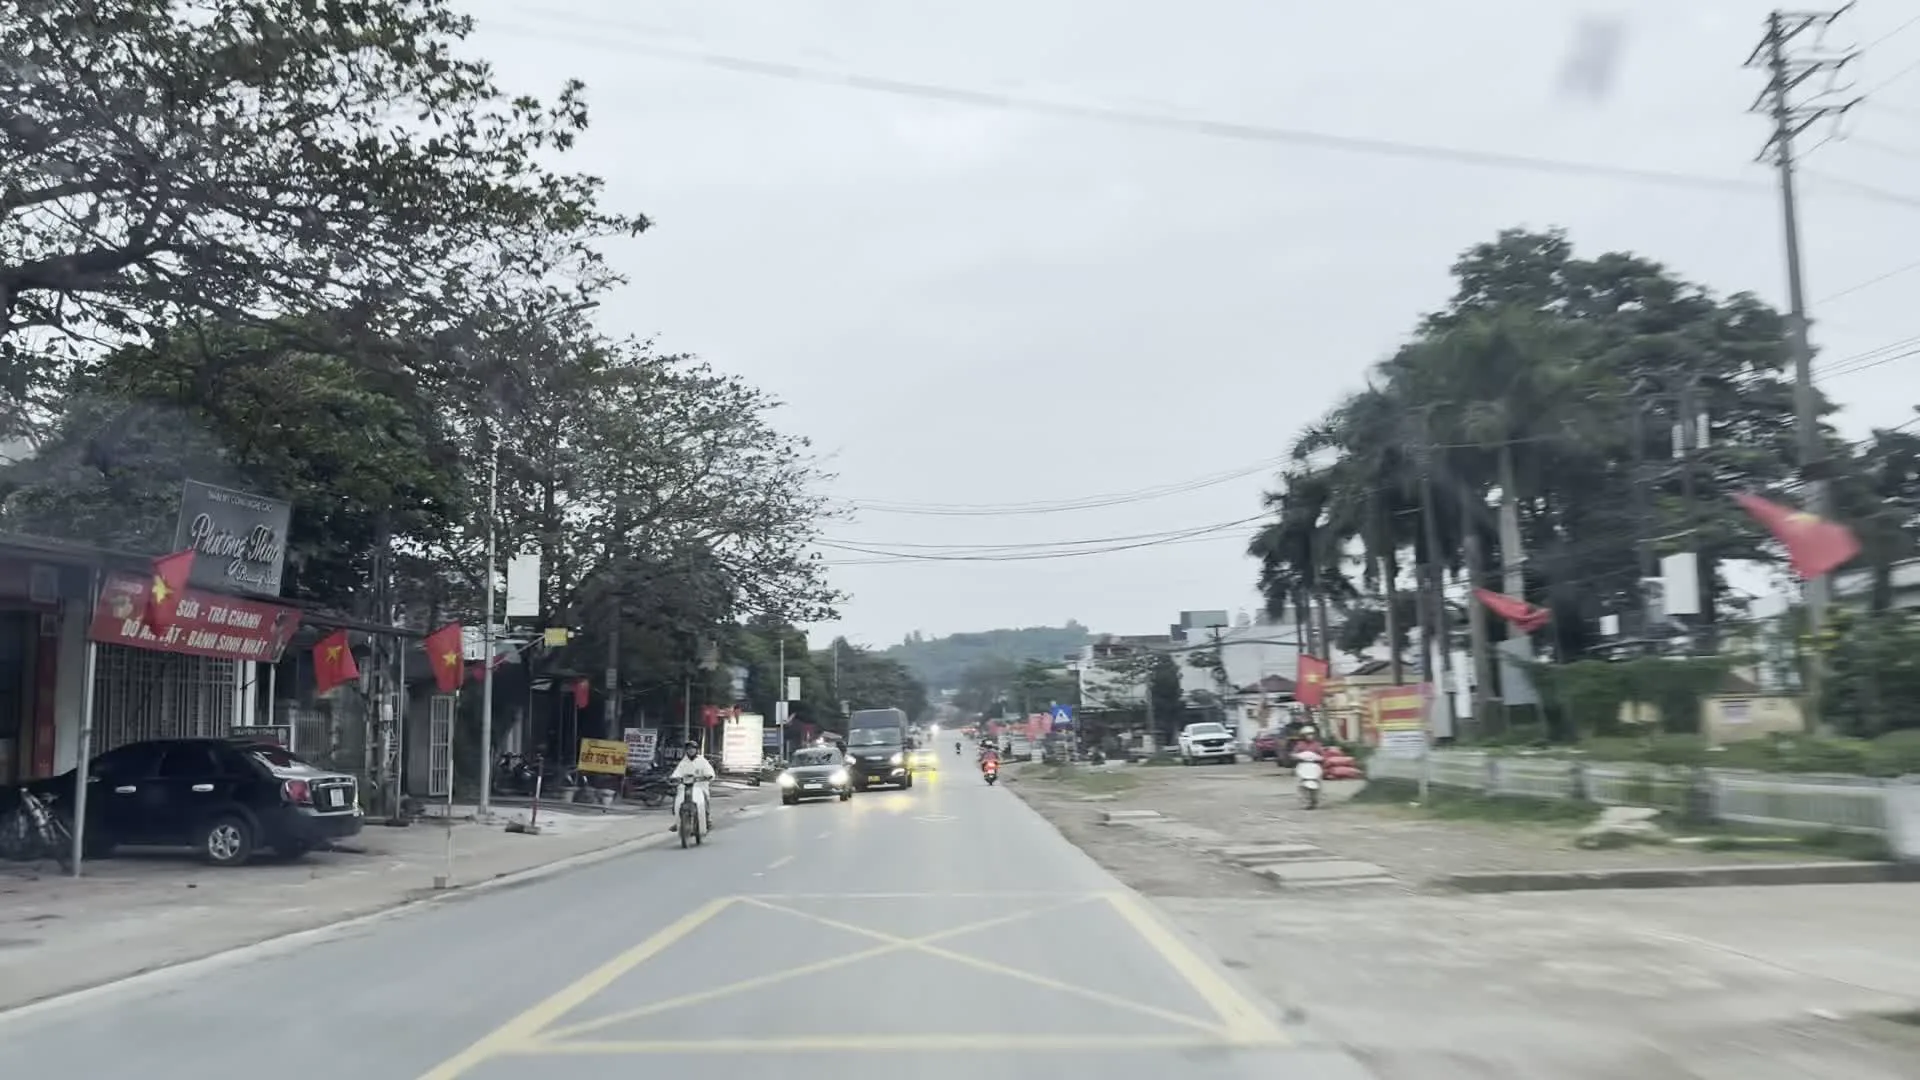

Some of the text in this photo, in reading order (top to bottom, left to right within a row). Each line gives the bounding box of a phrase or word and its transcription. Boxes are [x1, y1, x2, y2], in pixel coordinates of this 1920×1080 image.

[227, 609, 263, 630] CHANH
[187, 628, 218, 649] BÁNH
[216, 634, 243, 652] SINH
